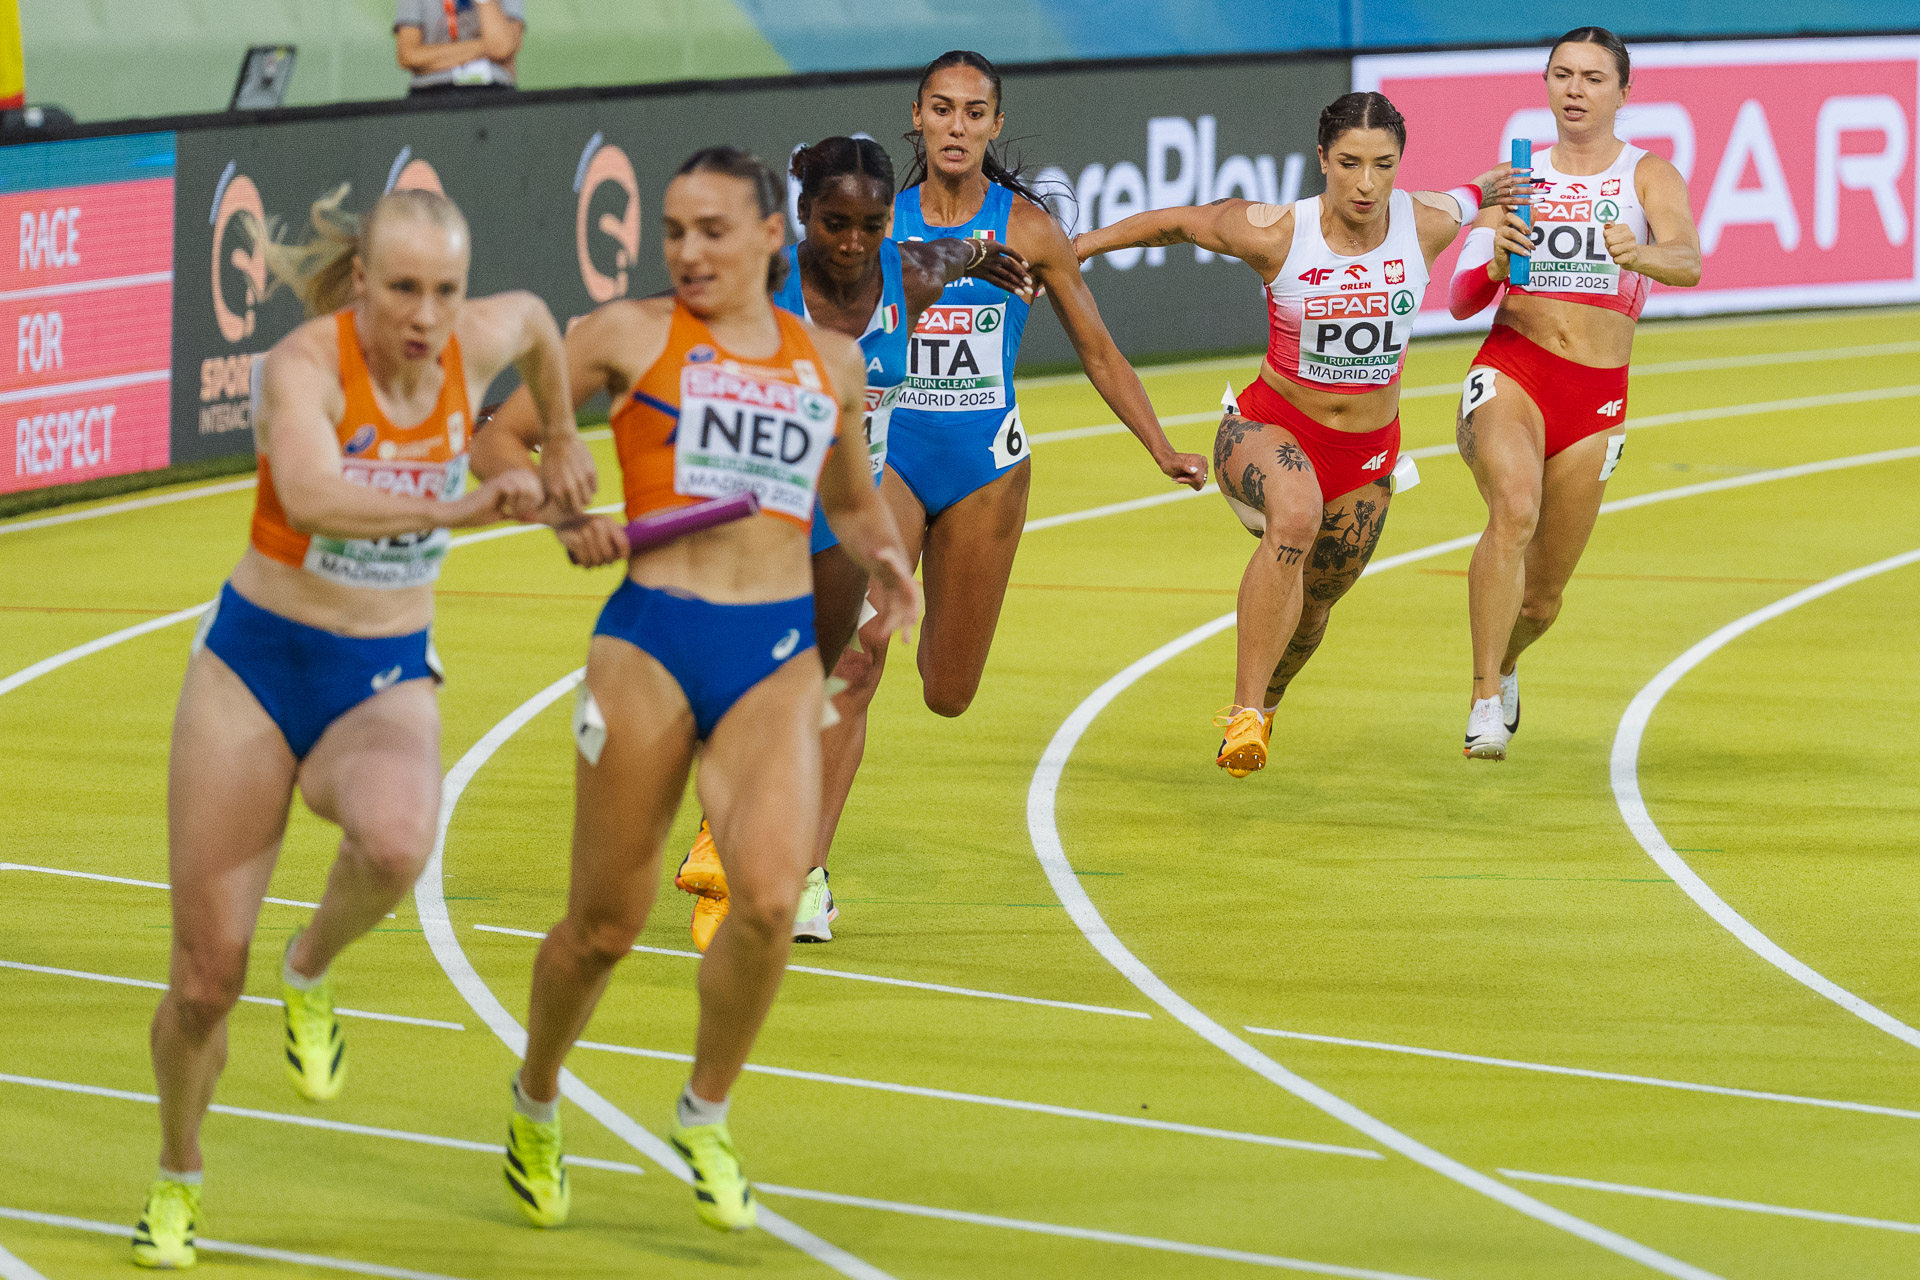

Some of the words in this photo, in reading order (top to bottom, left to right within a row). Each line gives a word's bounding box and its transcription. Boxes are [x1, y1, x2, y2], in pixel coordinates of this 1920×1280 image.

[19, 207, 81, 271] RACE
[1530, 225, 1607, 261] POL
[1298, 268, 1334, 286] 4F
[1534, 263, 1557, 271] RUN
[1340, 282, 1371, 290] ORLEN
[1575, 276, 1609, 289] 2025
[1307, 295, 1387, 317] SPAR
[17, 311, 63, 373] FOR
[1316, 320, 1402, 355] POL
[910, 337, 980, 376] ITA
[1329, 357, 1352, 366] RUN
[913, 378, 936, 388] RUN
[1308, 364, 1368, 380] MADRID
[689, 368, 795, 412] SPAR
[897, 391, 956, 407] MADRID
[959, 391, 996, 406] 2025
[1470, 373, 1484, 404] 5
[1597, 398, 1624, 417] 4F
[15, 405, 116, 477] RESPECT
[700, 404, 810, 465] NED
[1006, 418, 1023, 457] 6
[1361, 449, 1389, 471] 4F
[1276, 544, 1304, 566] 777
